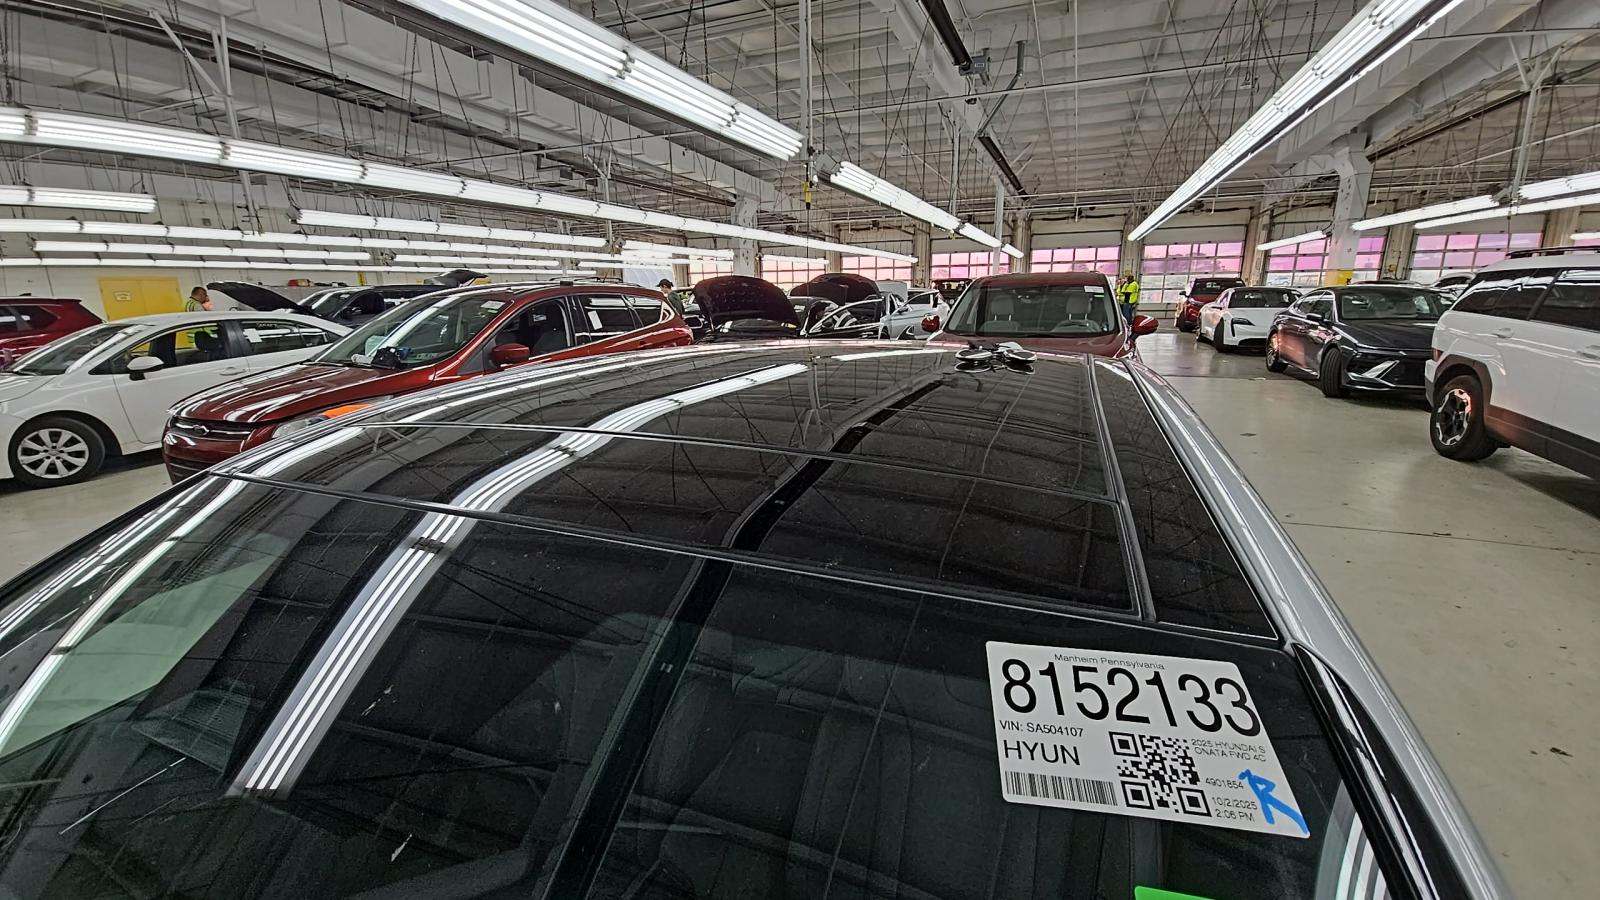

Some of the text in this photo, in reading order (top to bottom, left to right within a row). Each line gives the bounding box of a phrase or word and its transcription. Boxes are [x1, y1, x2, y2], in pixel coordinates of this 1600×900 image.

[1054, 653, 1165, 670] Manheim Pennsylvania
[1001, 658, 1262, 738] 8152133
[999, 720, 1084, 738] VIN: SA504107
[1003, 739, 1081, 765] HYUN
[1191, 738, 1213, 748] 2025
[1215, 741, 1257, 752] HYUNDAI
[1229, 750, 1251, 760] FWD
[1205, 777, 1244, 789] 4901854
[1212, 797, 1258, 810] 10/2/2025
[1239, 811, 1255, 822] PM
